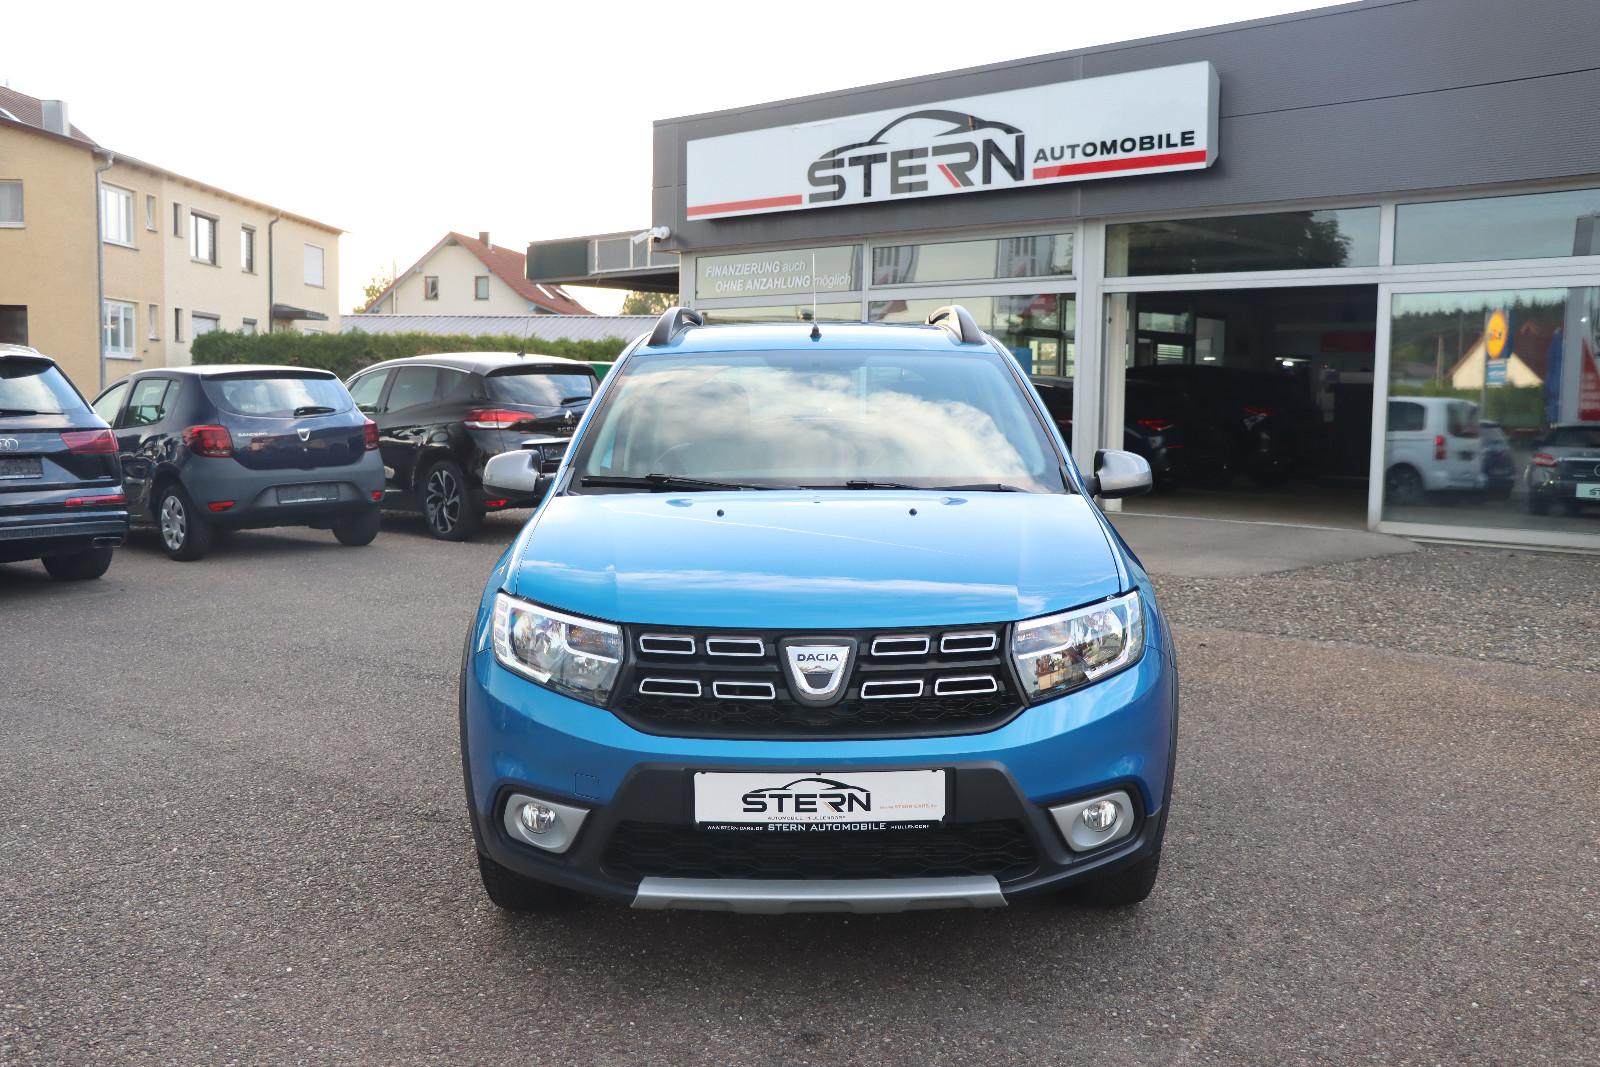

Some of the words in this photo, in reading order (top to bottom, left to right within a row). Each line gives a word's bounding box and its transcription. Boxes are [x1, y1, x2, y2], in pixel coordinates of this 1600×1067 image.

[1033, 130, 1195, 164] AUTOMOBILE
[807, 134, 1025, 204] STERN
[705, 260, 780, 277] FINANZIERUNG
[782, 259, 807, 273] auch
[715, 279, 744, 293] OHNE
[746, 275, 811, 291] ANZAHLUNG
[813, 272, 851, 288] möglich
[796, 653, 839, 662] DACIA
[741, 792, 872, 813] STERN
[767, 823, 806, 831] STERN
[809, 822, 887, 831] AUTOMOBILE
